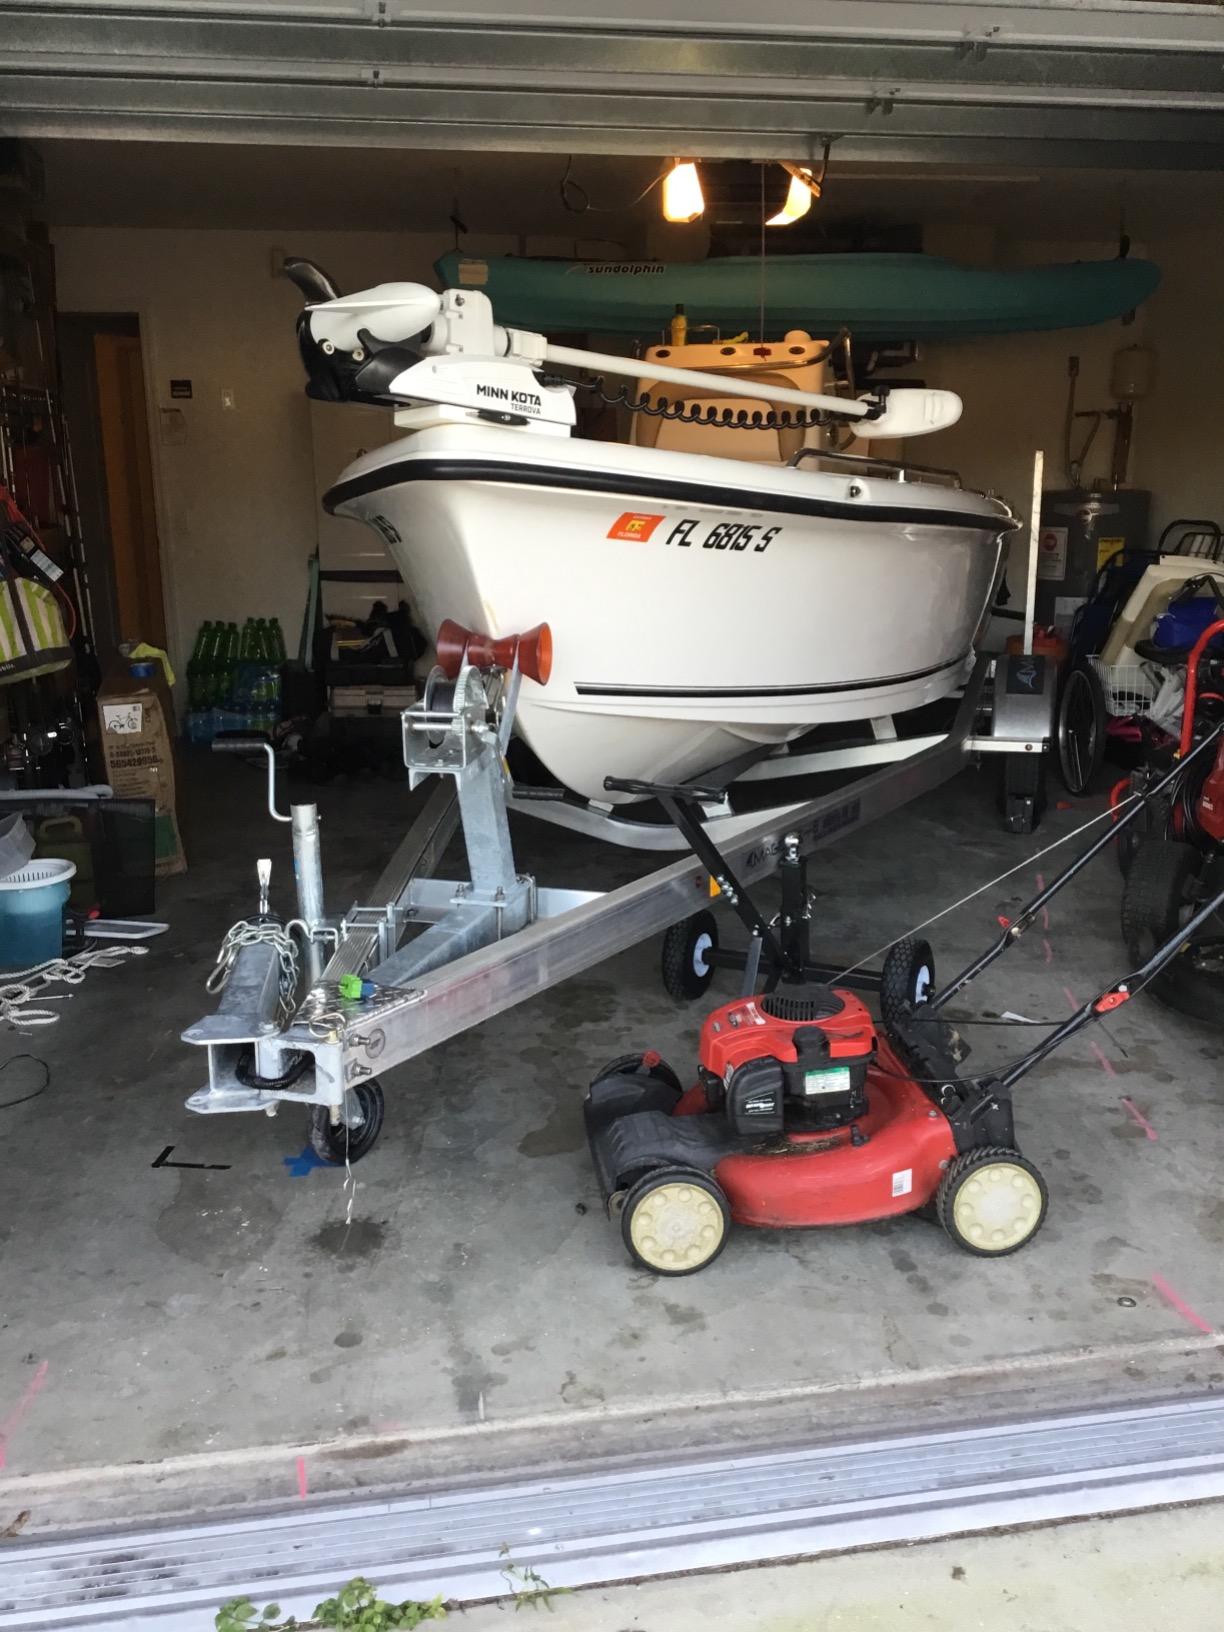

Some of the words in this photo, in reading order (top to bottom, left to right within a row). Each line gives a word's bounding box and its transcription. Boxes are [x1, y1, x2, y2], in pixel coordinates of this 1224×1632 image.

[588, 264, 665, 275] sundolphin
[476, 383, 509, 401] MINN
[511, 390, 542, 406] KOTA
[511, 403, 541, 414] TERROVA
[665, 519, 701, 547] FL
[702, 522, 763, 551] 6815
[754, 526, 783, 552] S
